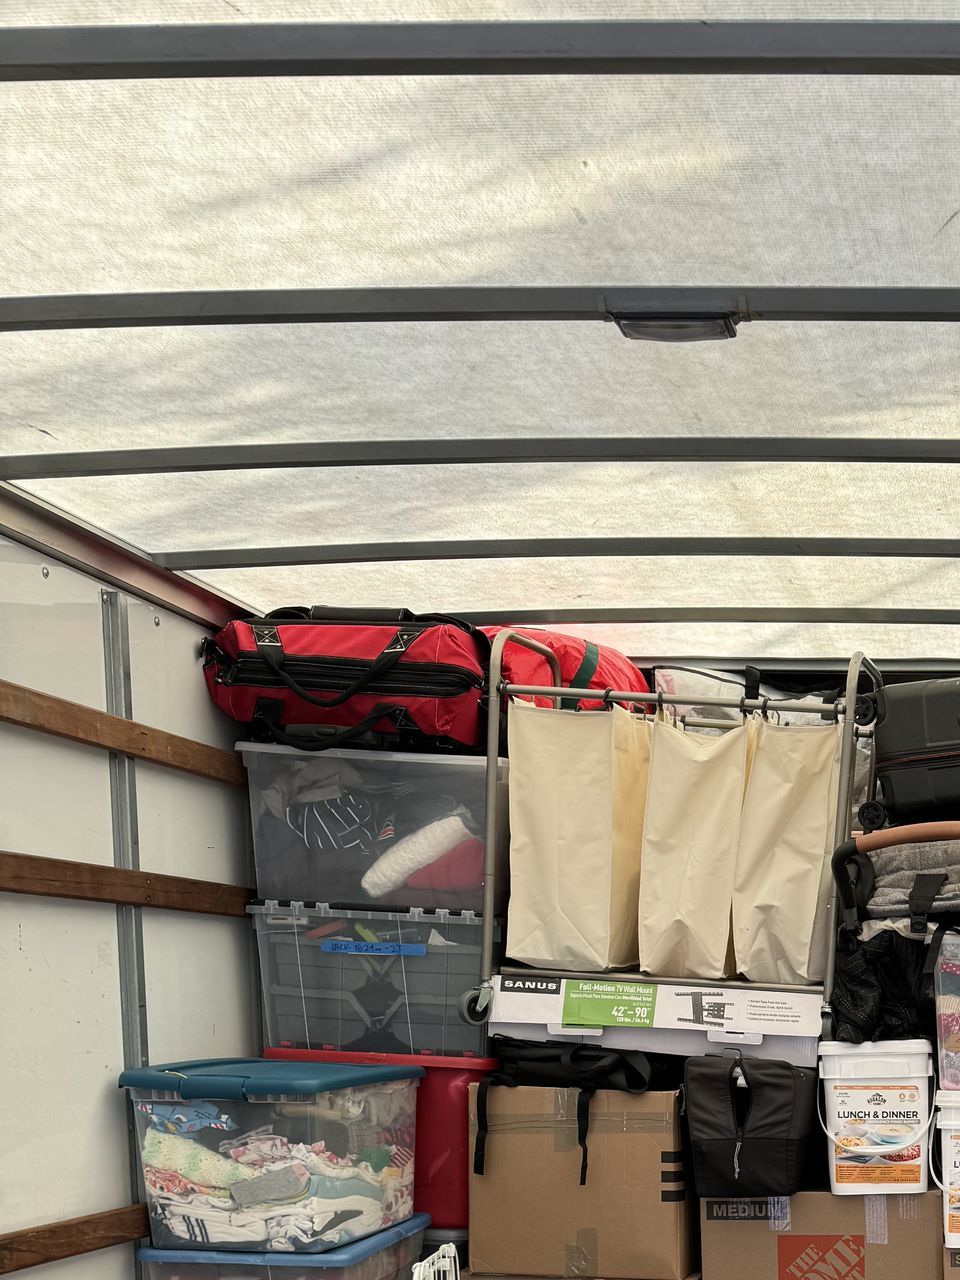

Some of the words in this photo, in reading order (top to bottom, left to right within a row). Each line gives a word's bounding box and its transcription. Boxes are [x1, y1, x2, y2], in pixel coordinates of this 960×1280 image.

[504, 980, 557, 990] SANUS
[579, 983, 615, 992] Full-Motion
[624, 985, 636, 993] Wall
[636, 986, 653, 994] Mount
[837, 1111, 870, 1119] LUNCH
[873, 1111, 880, 1119] &
[882, 1111, 918, 1119] DINNER
[786, 1244, 822, 1278] THE
